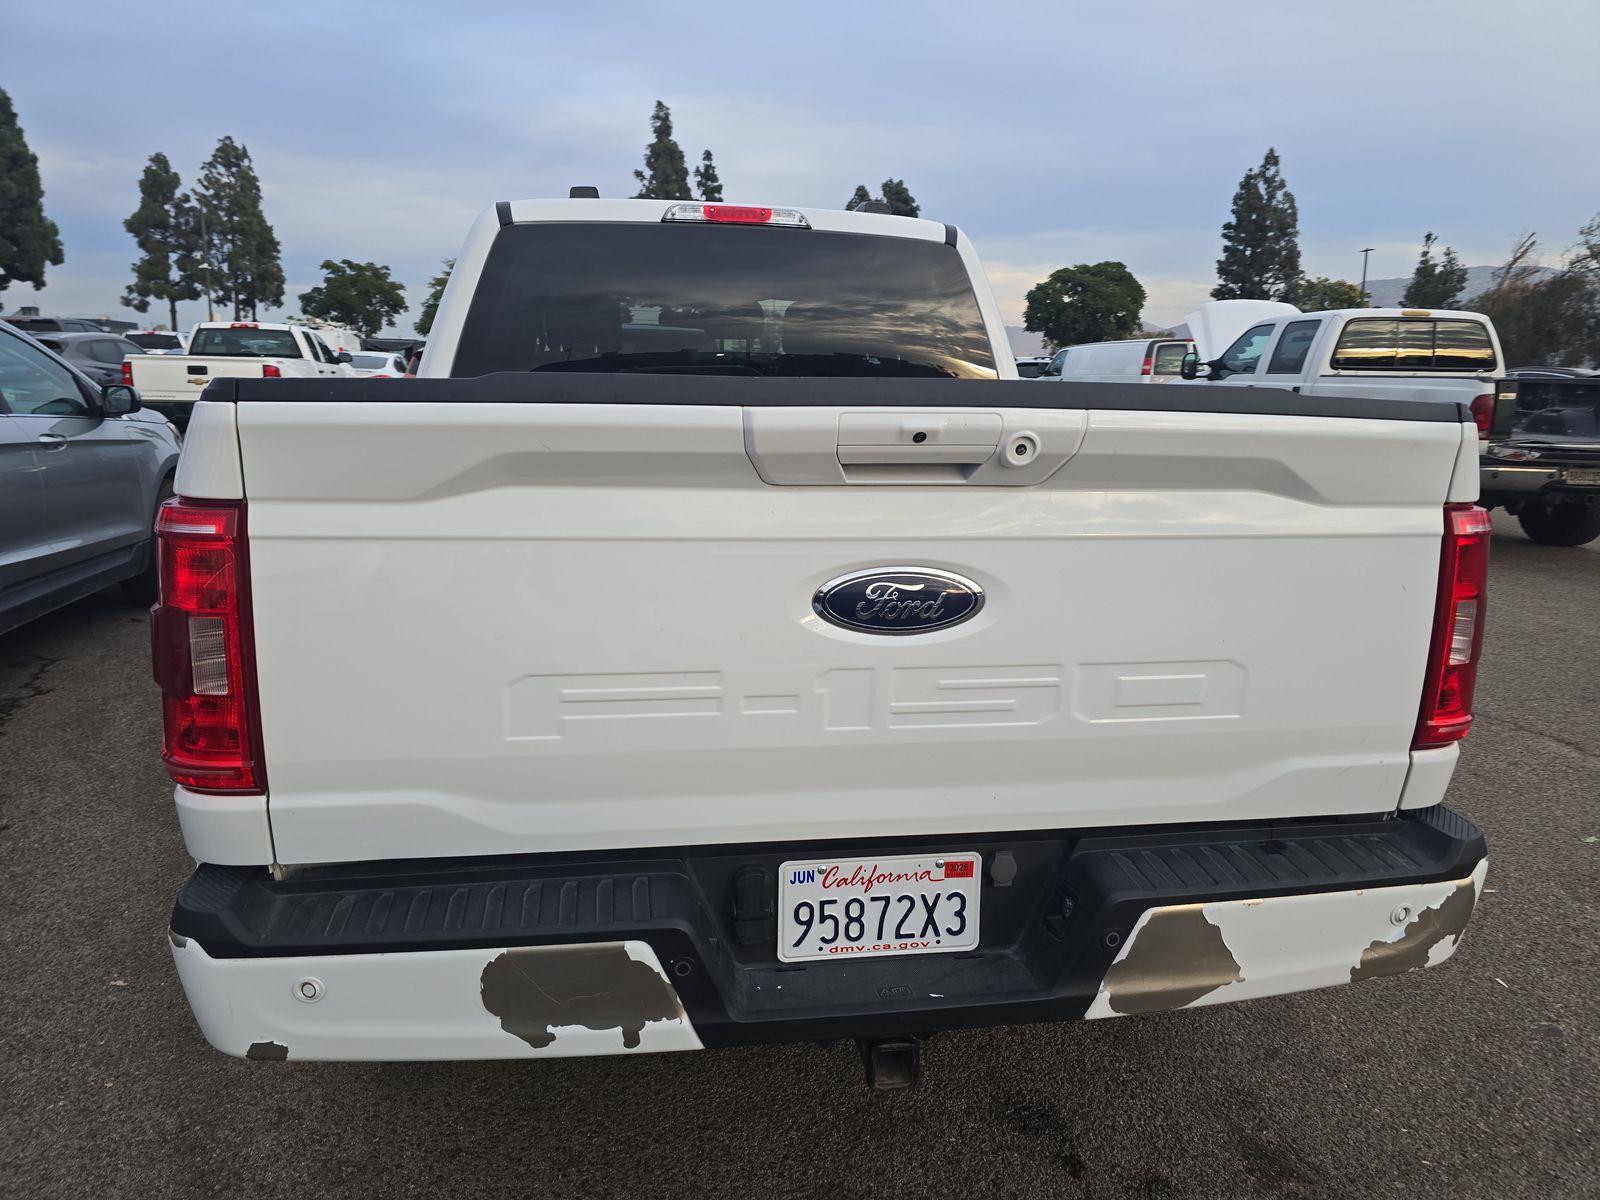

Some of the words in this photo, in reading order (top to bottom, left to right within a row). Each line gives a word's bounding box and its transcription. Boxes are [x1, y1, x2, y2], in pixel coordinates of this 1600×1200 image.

[855, 582, 947, 619] Ford
[503, 659, 1248, 741] F-150
[790, 870, 815, 885] JUN
[822, 864, 945, 893] California
[950, 863, 968, 871] 2026
[793, 892, 967, 948] 95872X3
[829, 941, 930, 953] dmv.ca.gov
